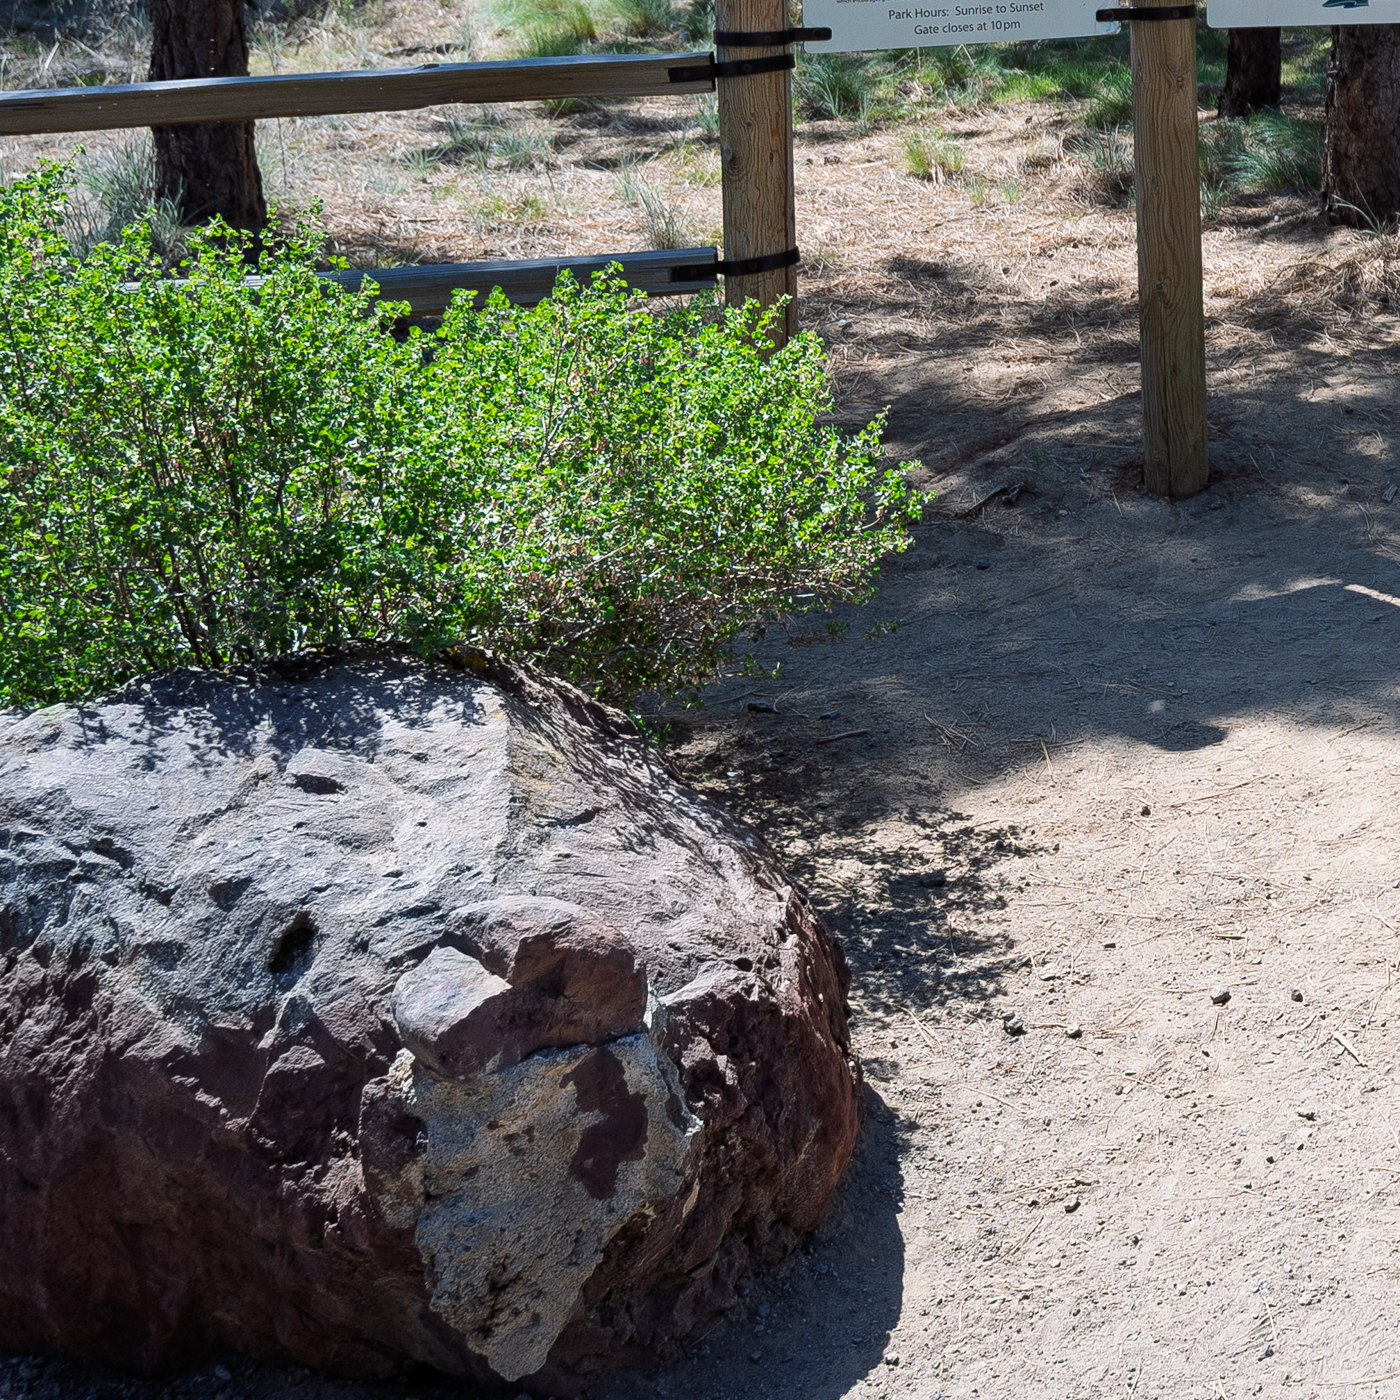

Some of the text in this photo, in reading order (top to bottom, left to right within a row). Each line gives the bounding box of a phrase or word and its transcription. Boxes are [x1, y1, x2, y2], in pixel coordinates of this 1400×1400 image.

[888, 1, 1044, 19] Park Hours: Sunrise to Sunset
[914, 23, 939, 34] Gate
[941, 21, 974, 33] closes
[976, 20, 986, 31] at
